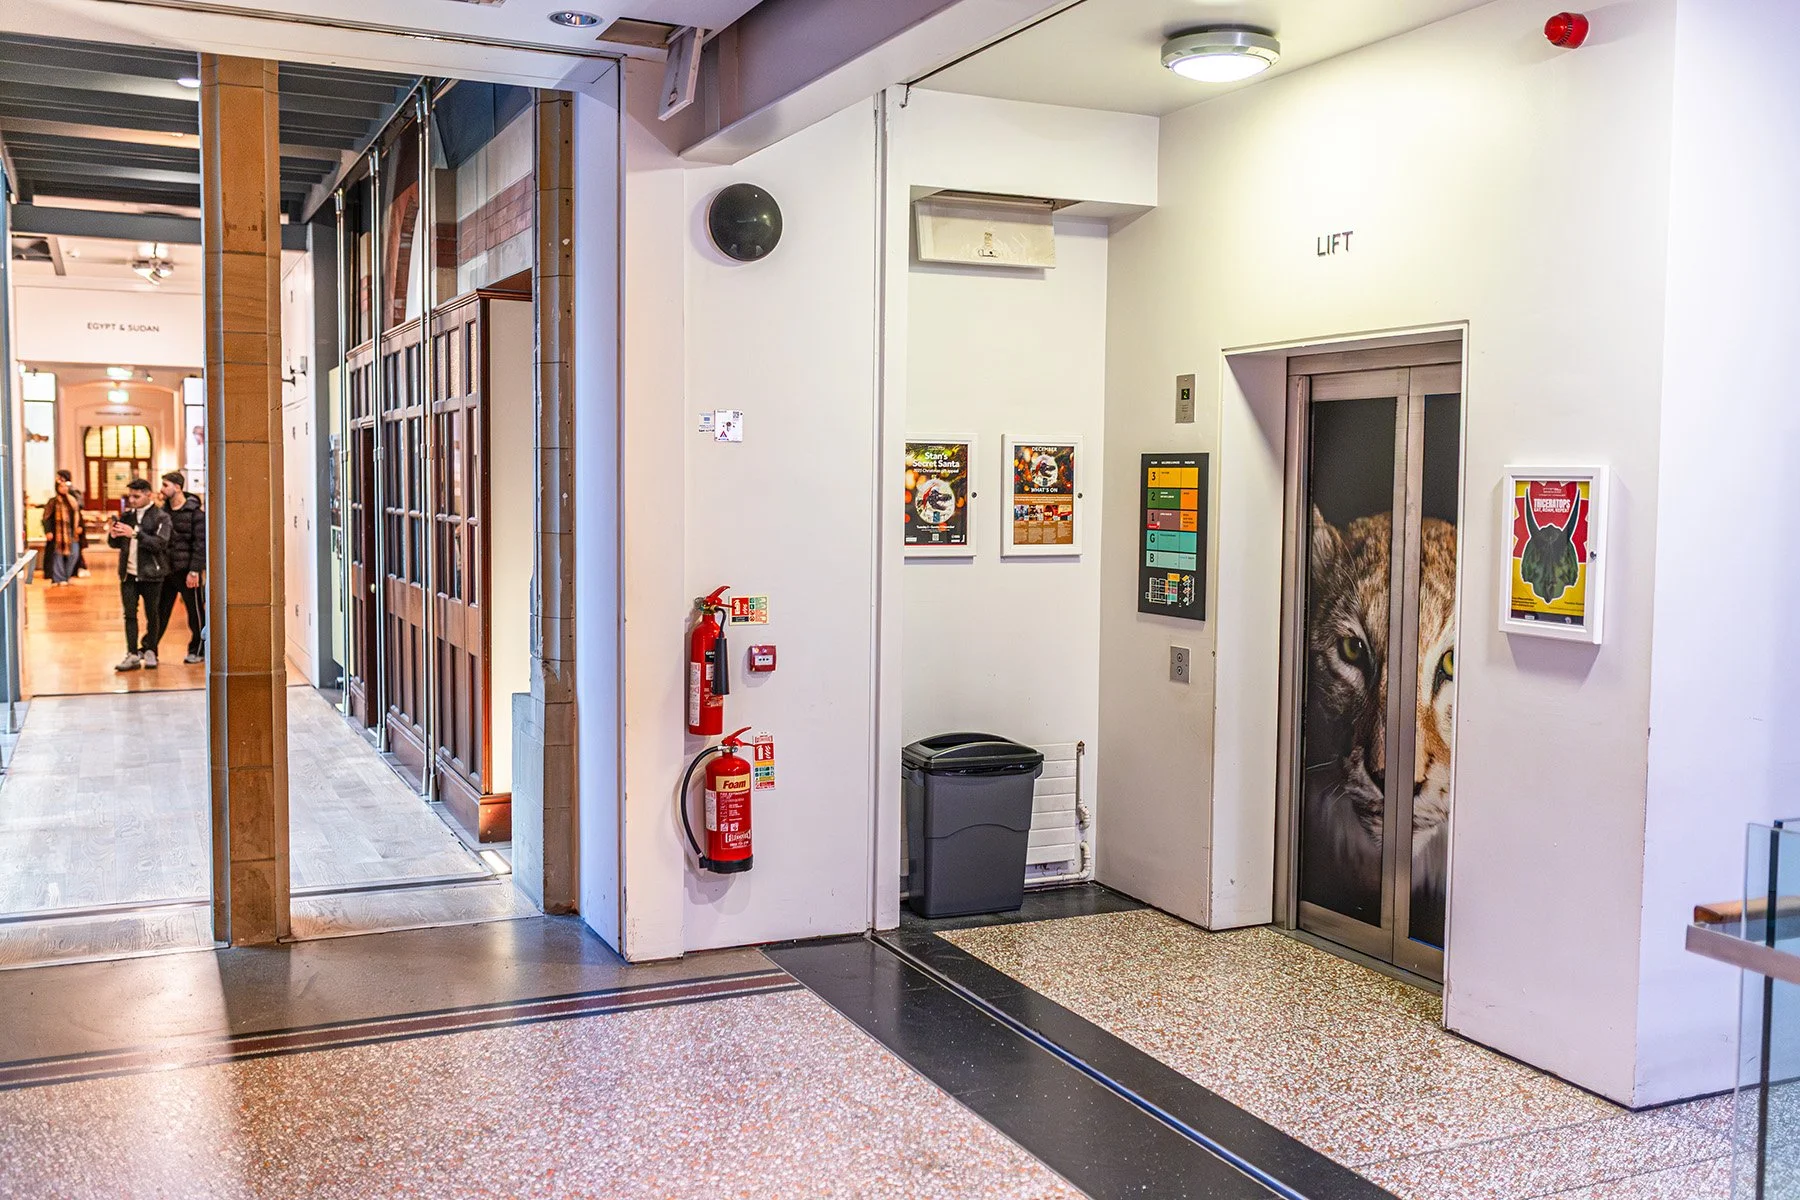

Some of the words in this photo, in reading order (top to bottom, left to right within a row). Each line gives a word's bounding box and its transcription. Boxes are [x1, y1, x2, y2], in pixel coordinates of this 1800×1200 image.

[1317, 230, 1353, 257] LIFT
[87, 322, 116, 331] EGYPT
[119, 323, 125, 332] &
[128, 324, 160, 332] SUDAN
[924, 451, 948, 460] Stan's
[912, 460, 937, 468] Secret
[938, 460, 960, 468] Santa
[1151, 471, 1156, 481] 3
[1151, 491, 1156, 501] 2
[1533, 498, 1571, 509] TRICERATOPS
[1151, 512, 1155, 521] 1
[1149, 533, 1155, 543] G
[1149, 553, 1155, 562] B
[723, 780, 746, 789] Foam
